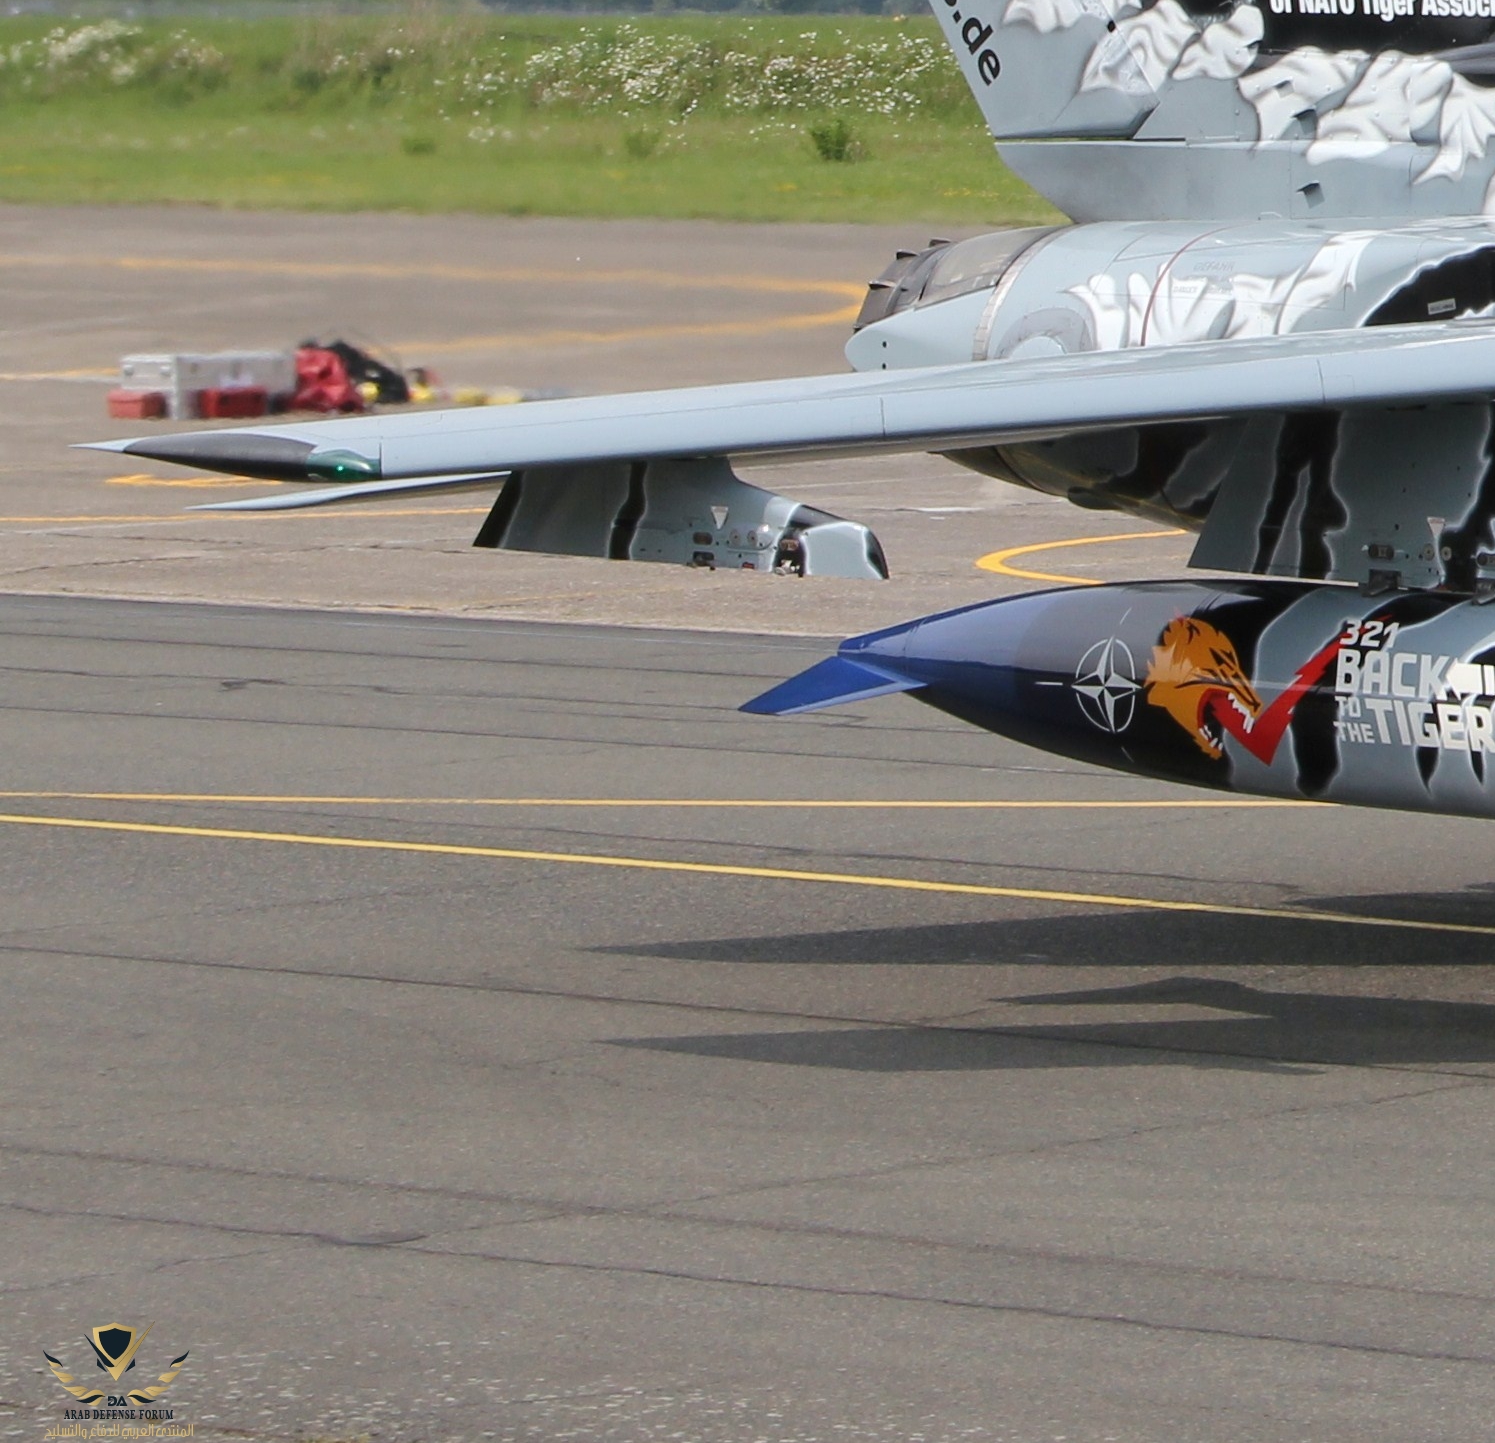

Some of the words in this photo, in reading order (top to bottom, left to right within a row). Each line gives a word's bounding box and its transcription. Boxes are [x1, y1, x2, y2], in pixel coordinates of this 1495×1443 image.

[1340, 619, 1399, 648] 321
[1335, 648, 1450, 701] BACK
[1335, 696, 1361, 718] TO
[1333, 721, 1376, 744] THE
